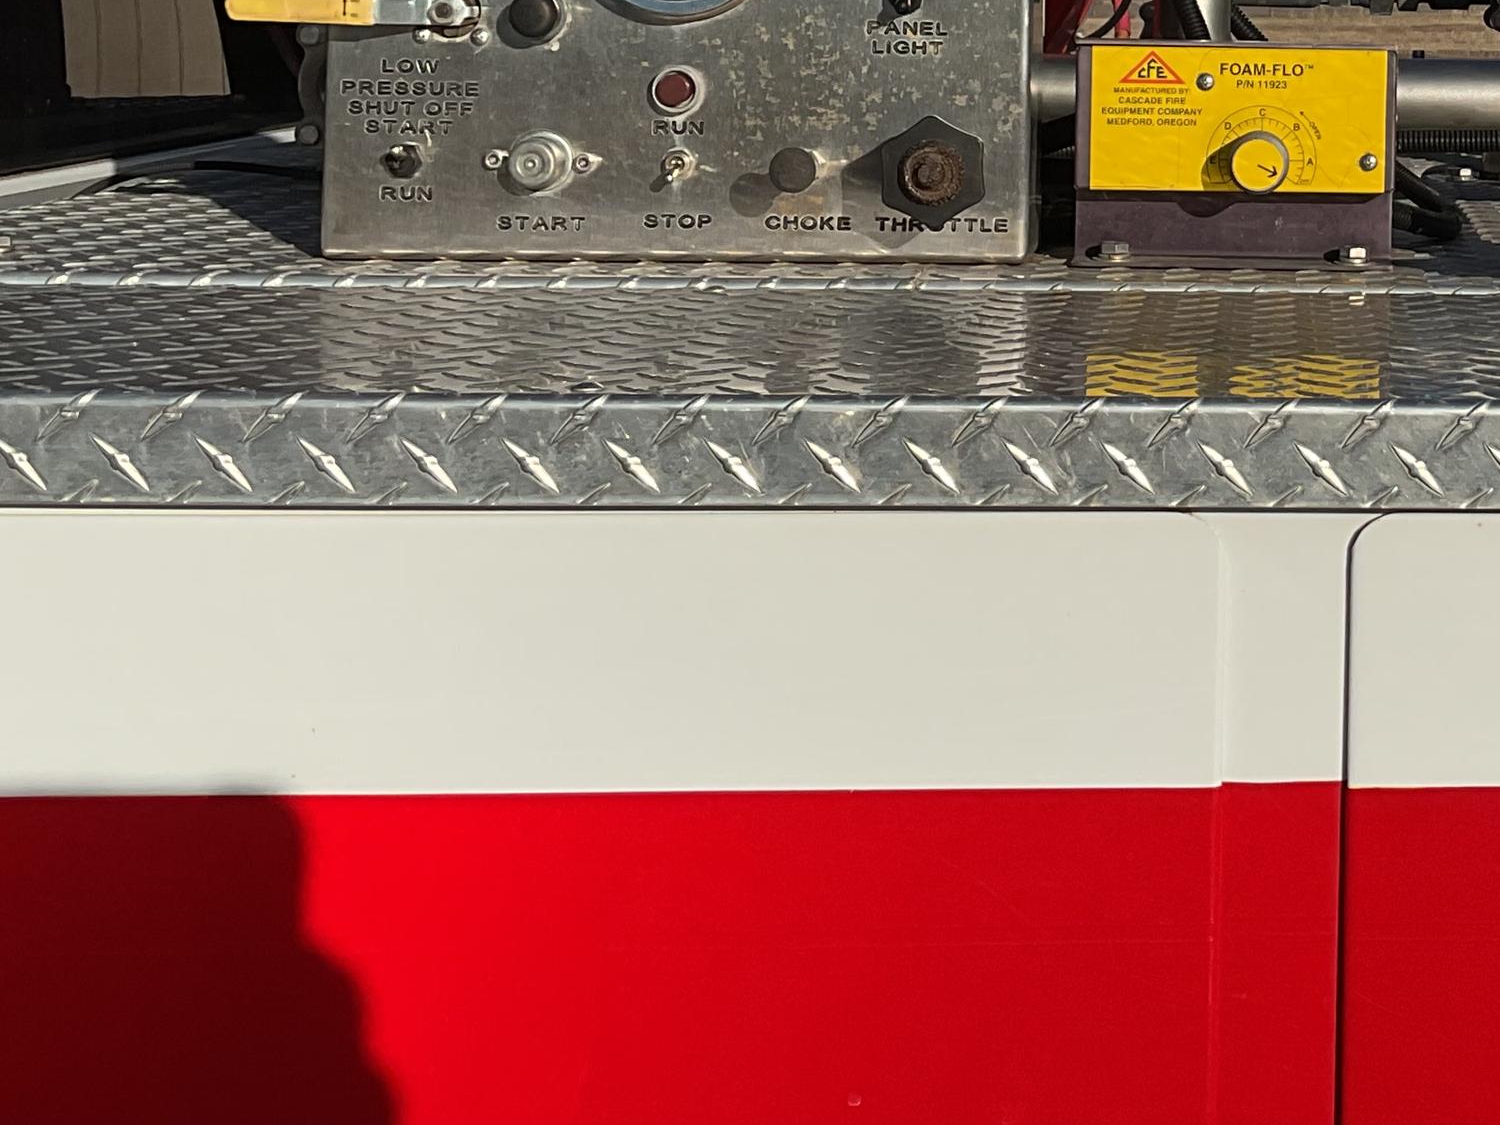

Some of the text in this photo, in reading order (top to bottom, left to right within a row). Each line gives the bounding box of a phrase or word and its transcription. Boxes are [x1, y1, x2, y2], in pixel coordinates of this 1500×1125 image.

[866, 21, 948, 36] PANEL
[872, 41, 944, 56] LIGHT
[381, 59, 440, 74] LOW
[341, 81, 480, 97] PRESSURE
[1113, 87, 1177, 95] MANUFACTURED
[1236, 79, 1288, 89] P/N 11923
[1118, 96, 1187, 105] CASCADE FIRE
[348, 101, 474, 117] SHUT OFF
[1101, 107, 1203, 116] EQUIPMENT COMPANY
[1259, 108, 1267, 117] C
[365, 120, 453, 135] START
[652, 120, 704, 136] RUN
[1157, 118, 1197, 127] OREGON
[1224, 122, 1232, 130] D
[1293, 123, 1301, 132] B
[1306, 157, 1314, 166] A
[379, 186, 433, 202] RUN
[497, 216, 586, 231] START
[643, 214, 712, 230] STOP
[765, 215, 852, 231] CHOKE
[875, 217, 1008, 232] THRTTLE
